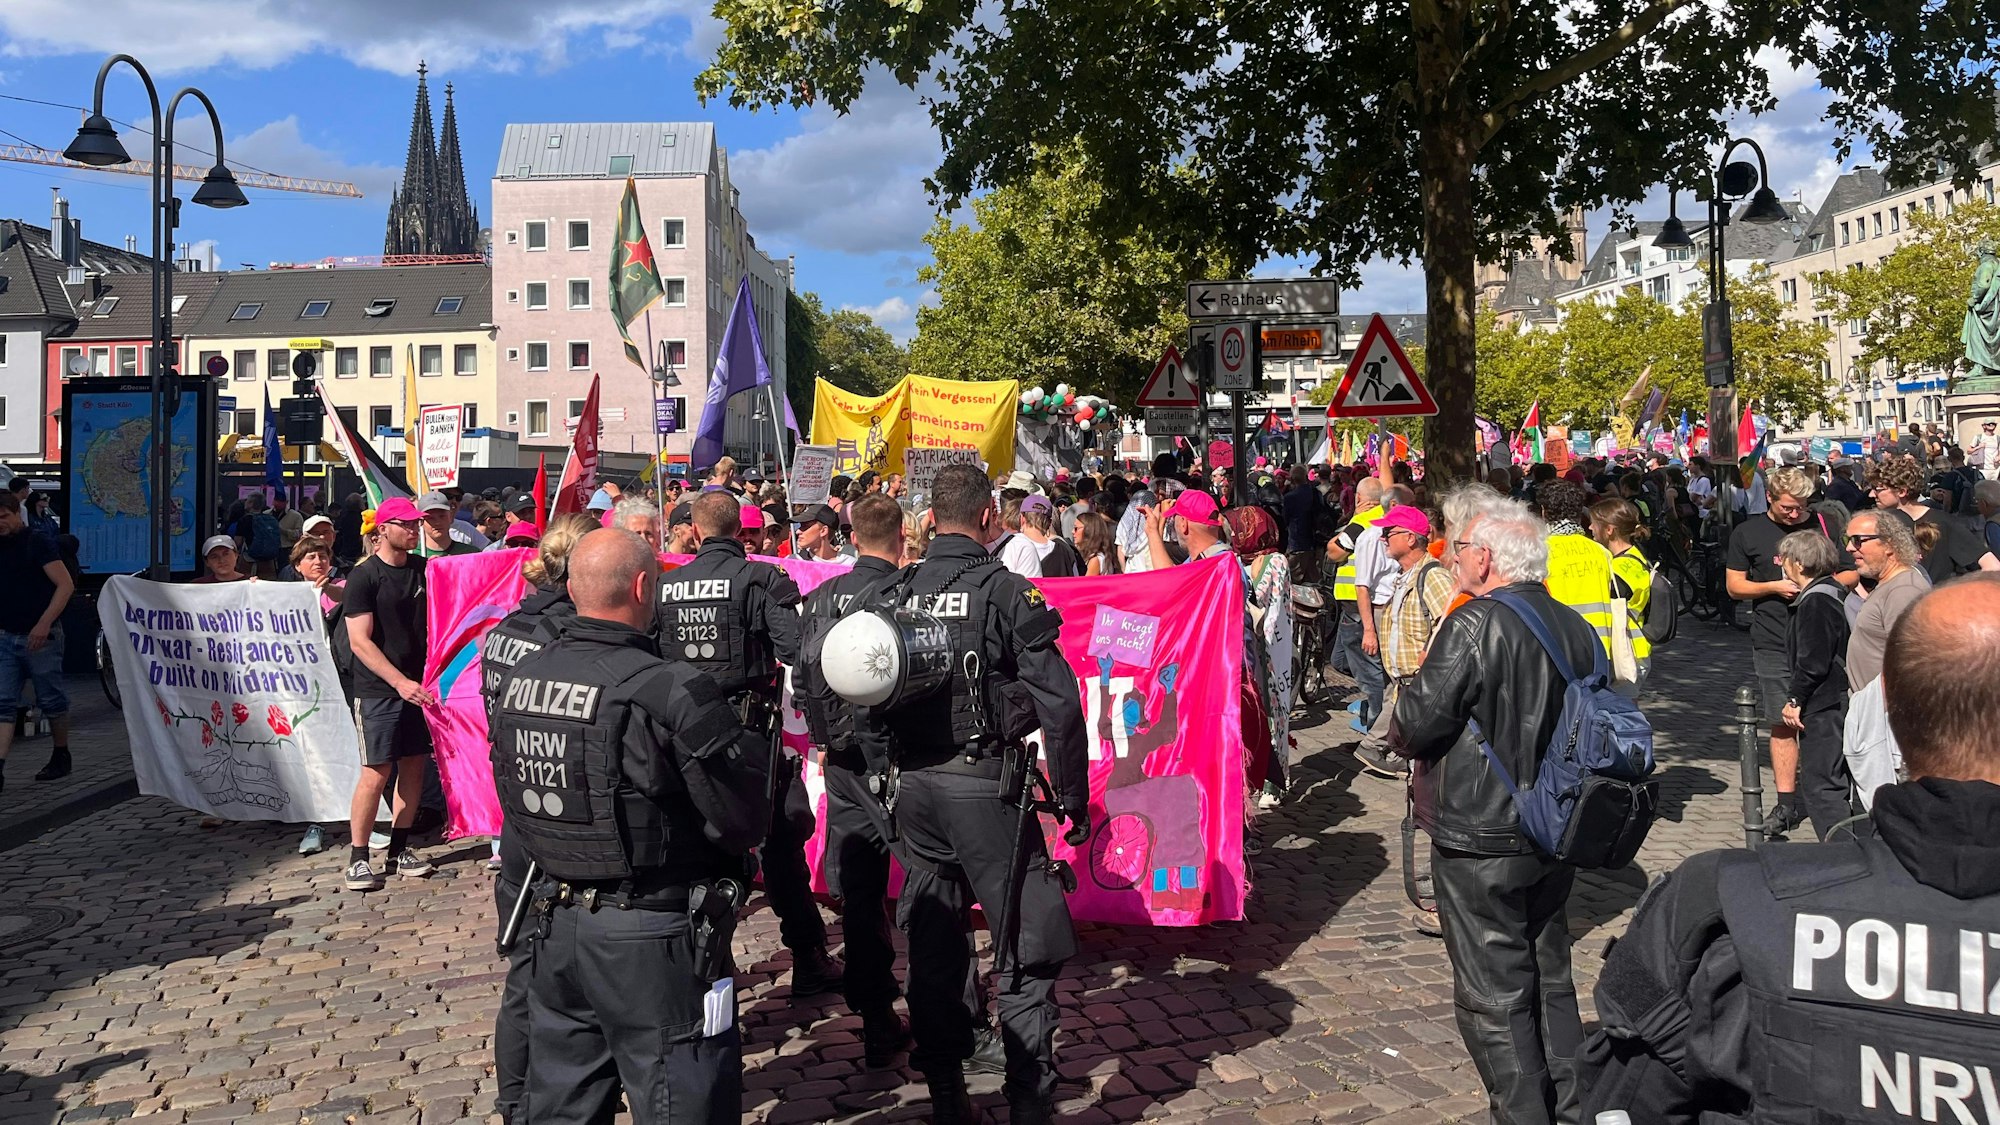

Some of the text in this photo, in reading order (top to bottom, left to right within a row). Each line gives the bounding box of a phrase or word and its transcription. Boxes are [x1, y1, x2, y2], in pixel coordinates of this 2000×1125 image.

[1220, 292, 1284, 306] Rathaus
[1226, 339, 1240, 359] 20
[1261, 333, 1318, 347] om/Rhein
[1224, 374, 1243, 386] ZONE
[908, 383, 997, 405] Kein Vergessen!
[425, 413, 445, 424] BULLEN
[900, 407, 985, 432] Gemeinsam
[1149, 410, 1194, 421] Baustellen-
[430, 424, 455, 435] BANKEN
[1156, 423, 1187, 433] verkehr
[427, 438, 454, 451] alle
[907, 432, 977, 450] verändern
[908, 450, 978, 466] PATRIARCHAT
[914, 466, 940, 476] ENTW
[911, 478, 933, 490] FRIED
[661, 579, 731, 602] POLIZEI
[245, 608, 264, 632] is
[269, 608, 314, 635] built
[678, 607, 717, 623] NRW
[677, 625, 718, 642] 31123
[1101, 612, 1154, 639] Ihr kriegt
[915, 625, 948, 647] RW
[1095, 634, 1151, 654] uns nicht!
[157, 638, 192, 661] war
[297, 640, 319, 664] is
[149, 660, 197, 689] built
[201, 669, 219, 692] on
[486, 669, 502, 692] NR
[503, 677, 600, 720] POLIZEI
[515, 728, 567, 759] NRW
[515, 757, 567, 788] 31121
